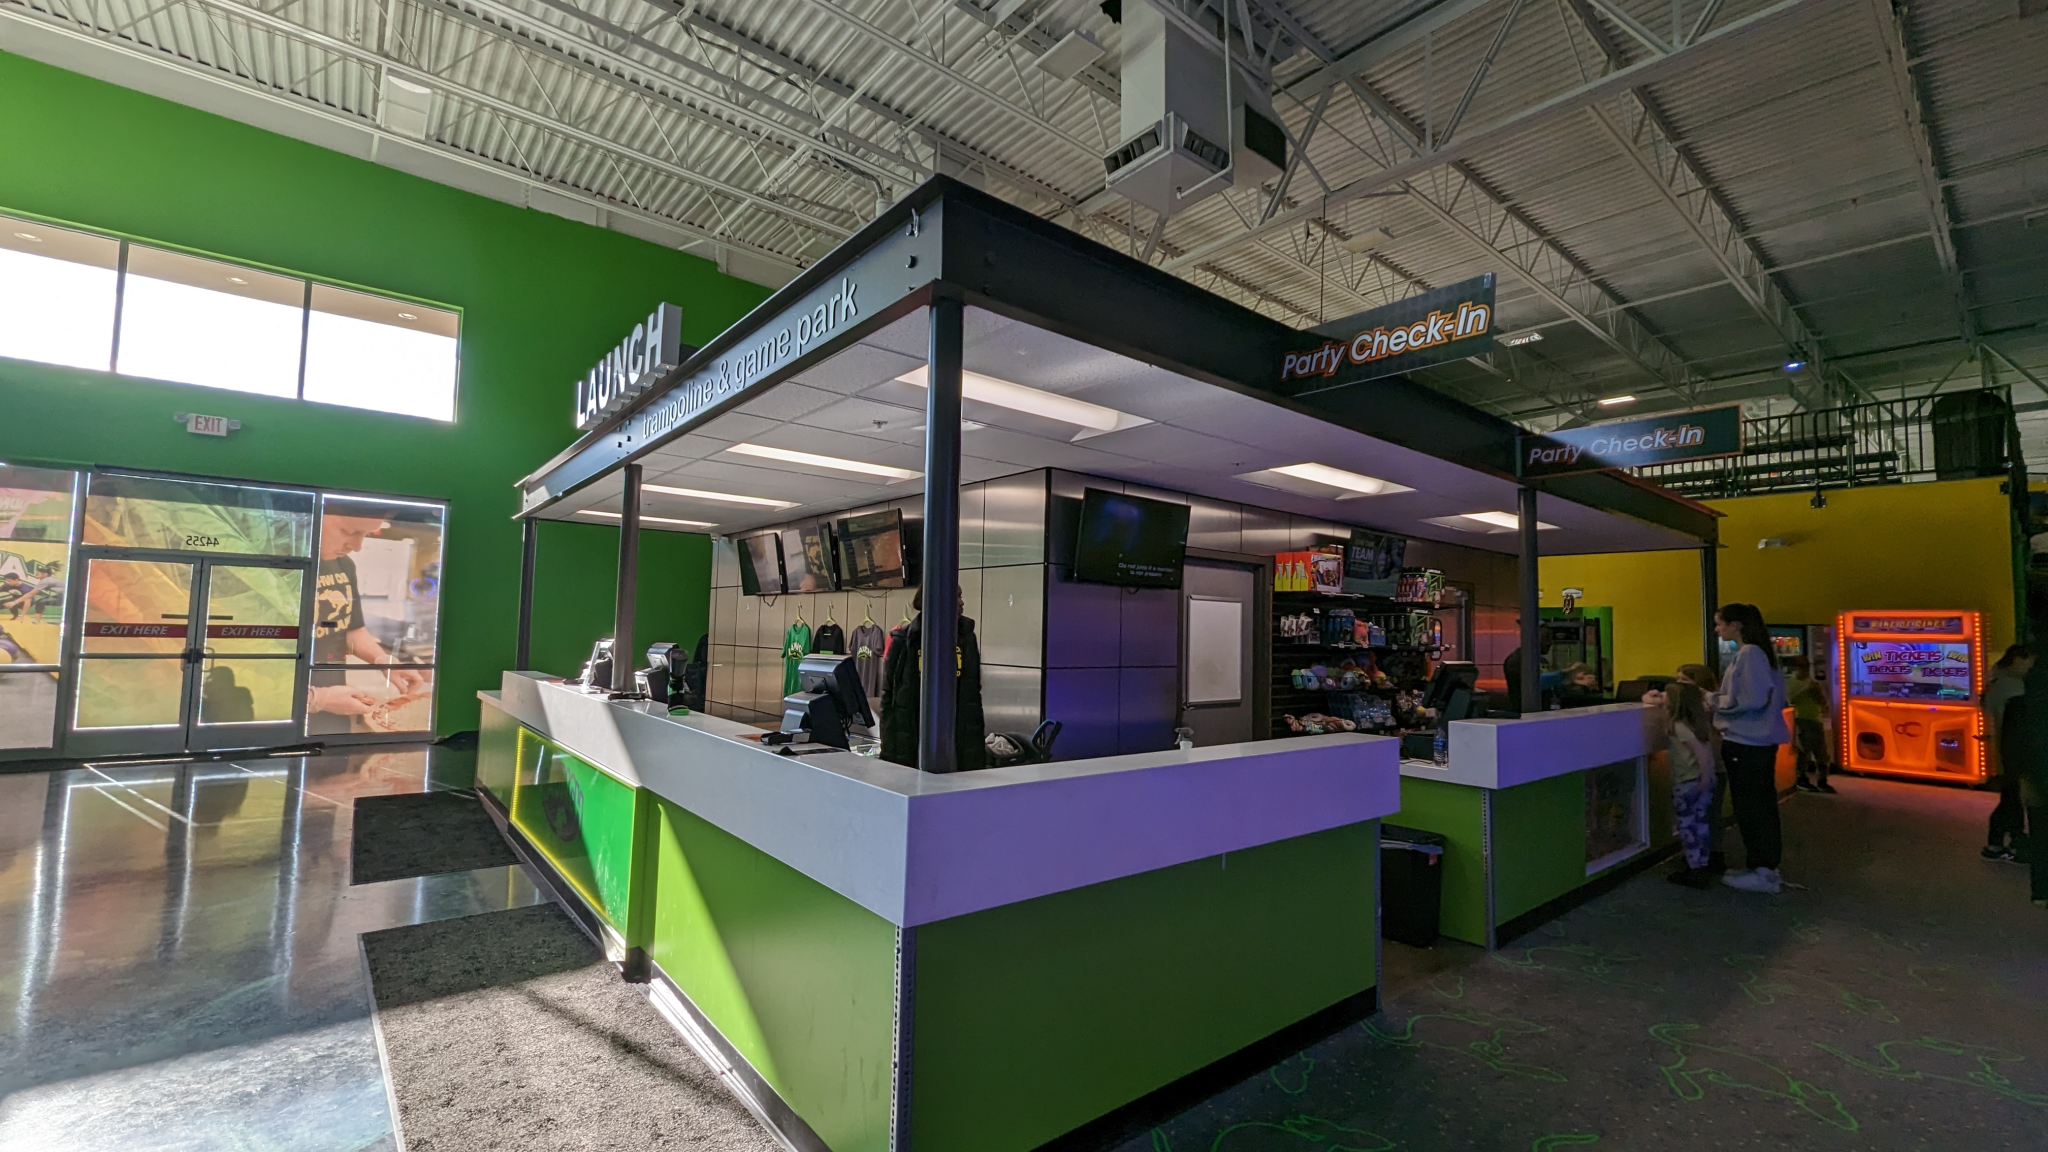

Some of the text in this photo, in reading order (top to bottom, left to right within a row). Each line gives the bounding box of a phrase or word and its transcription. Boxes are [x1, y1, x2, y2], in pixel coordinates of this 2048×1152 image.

[1281, 305, 1488, 379] Party Check-In
[576, 301, 670, 429] LAUNCH
[642, 277, 857, 440] trampoline & game park
[194, 415, 222, 432] EXIT
[1529, 425, 1703, 465] Party Check-In
[1351, 546, 1374, 561] TEAM
[99, 625, 168, 636] EXIT HERE
[220, 627, 282, 637] EXIT HERE
[1862, 651, 1882, 663] WIN
[1885, 650, 1944, 663] TICKETS
[1867, 665, 1912, 675] TICKETS
[1921, 666, 1969, 677] TICKETS
